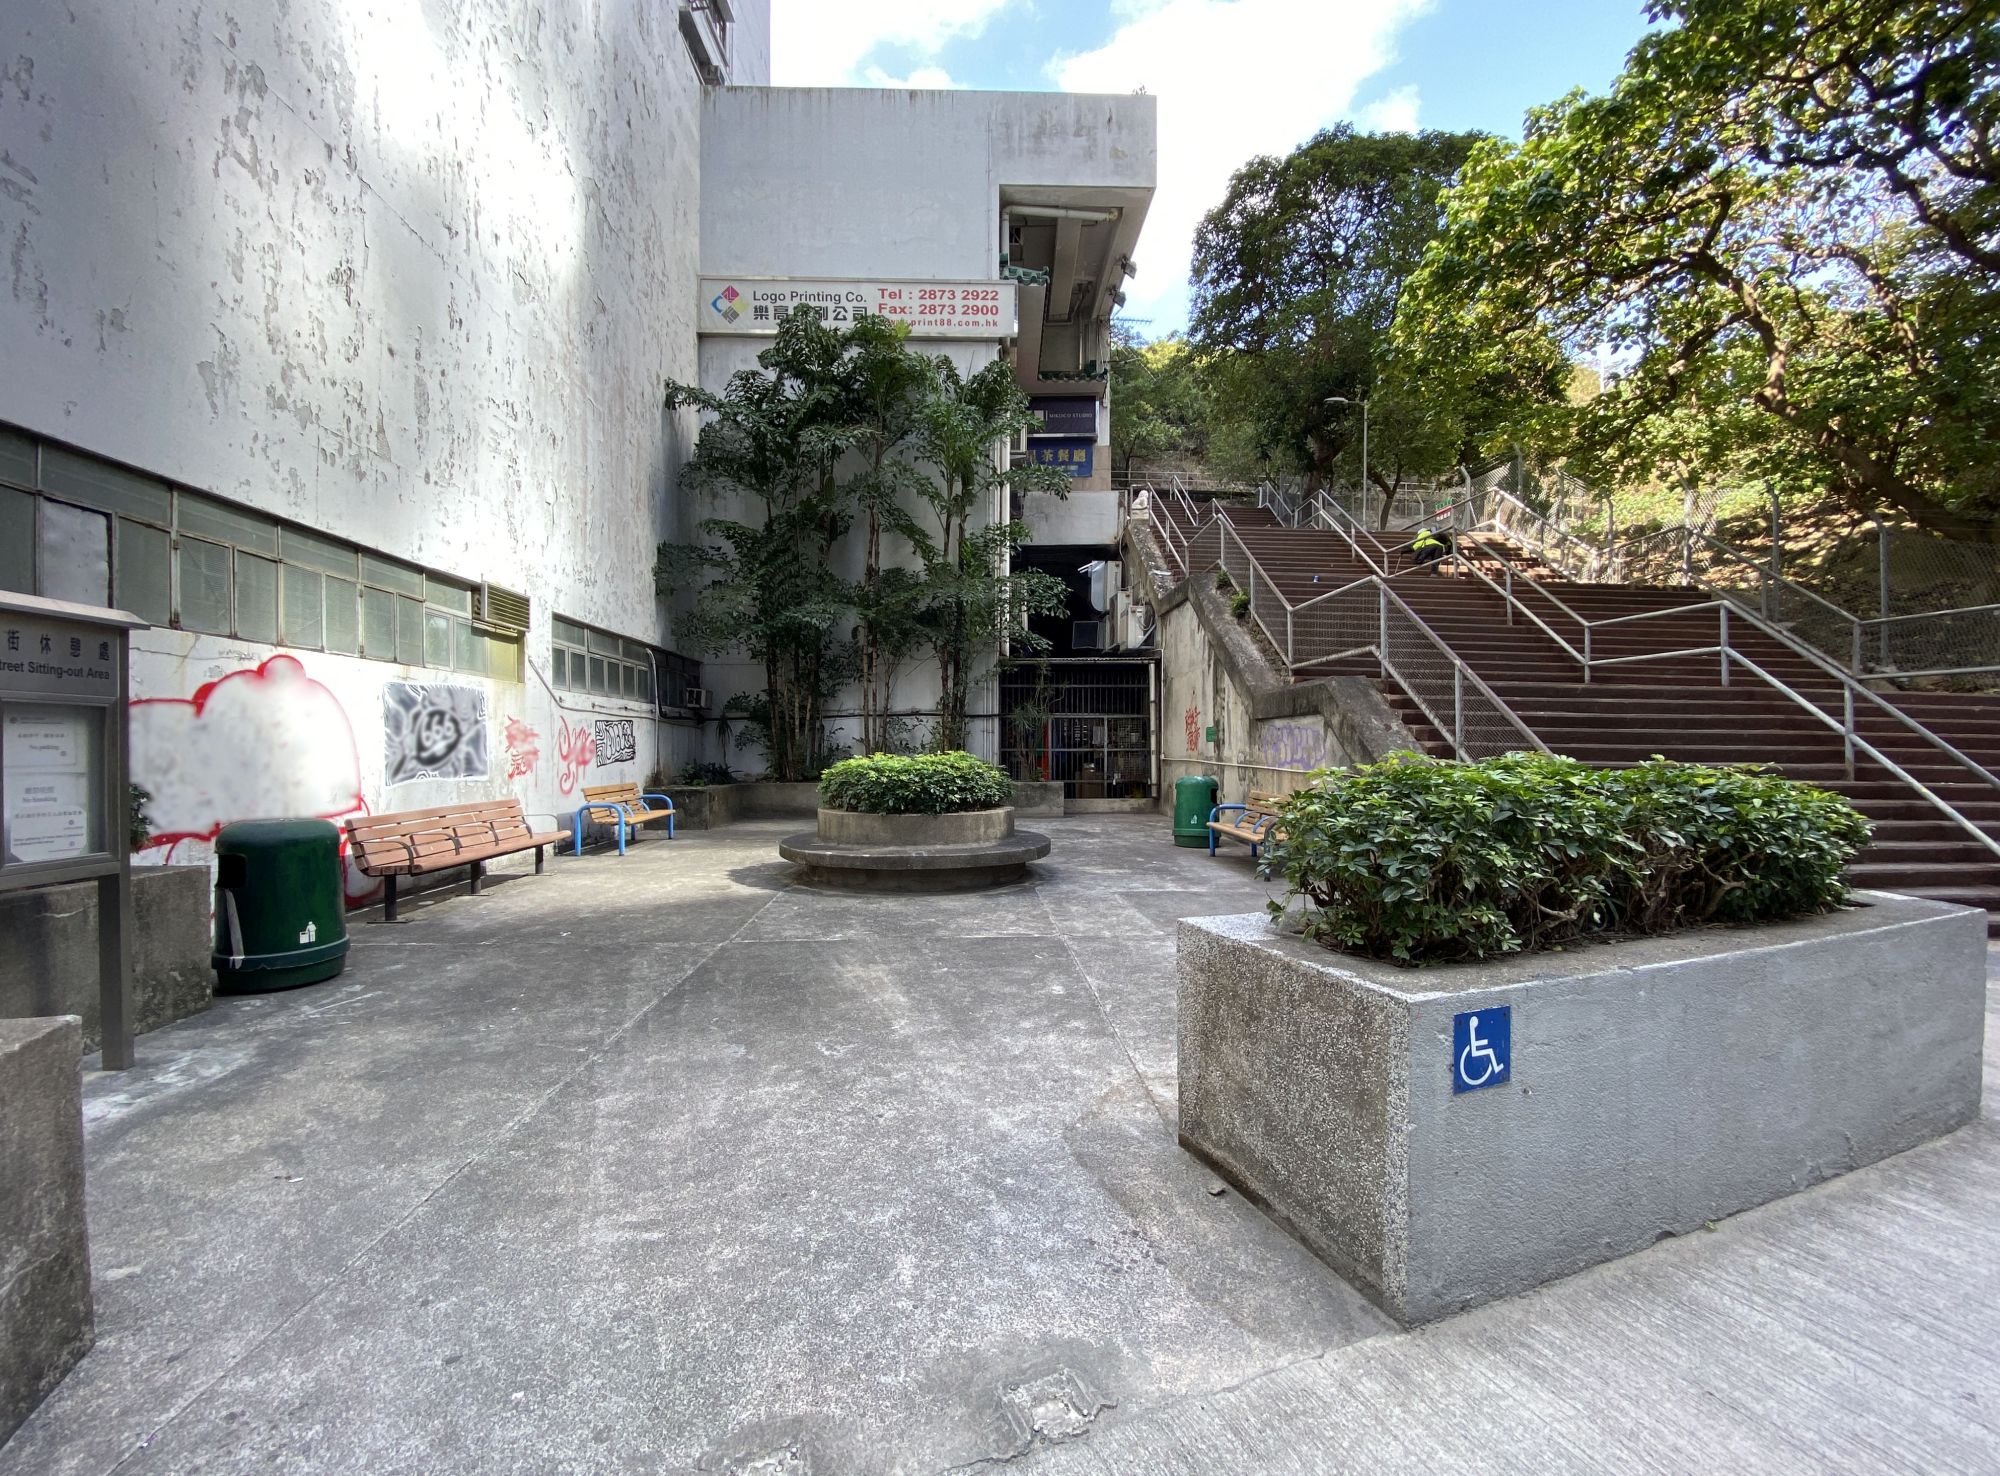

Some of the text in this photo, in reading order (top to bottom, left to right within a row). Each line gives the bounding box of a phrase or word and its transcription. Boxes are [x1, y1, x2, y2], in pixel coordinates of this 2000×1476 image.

[753, 290, 867, 305] Logo Printing Co.
[877, 288, 902, 300] Tel
[918, 289, 956, 300] 2873
[961, 290, 999, 301] 2922
[753, 305, 868, 320] 樂高刷公司
[878, 303, 999, 316] Fax: 2873 2900
[28, 661, 84, 679] Sitting-out
[87, 667, 110, 680] Area
